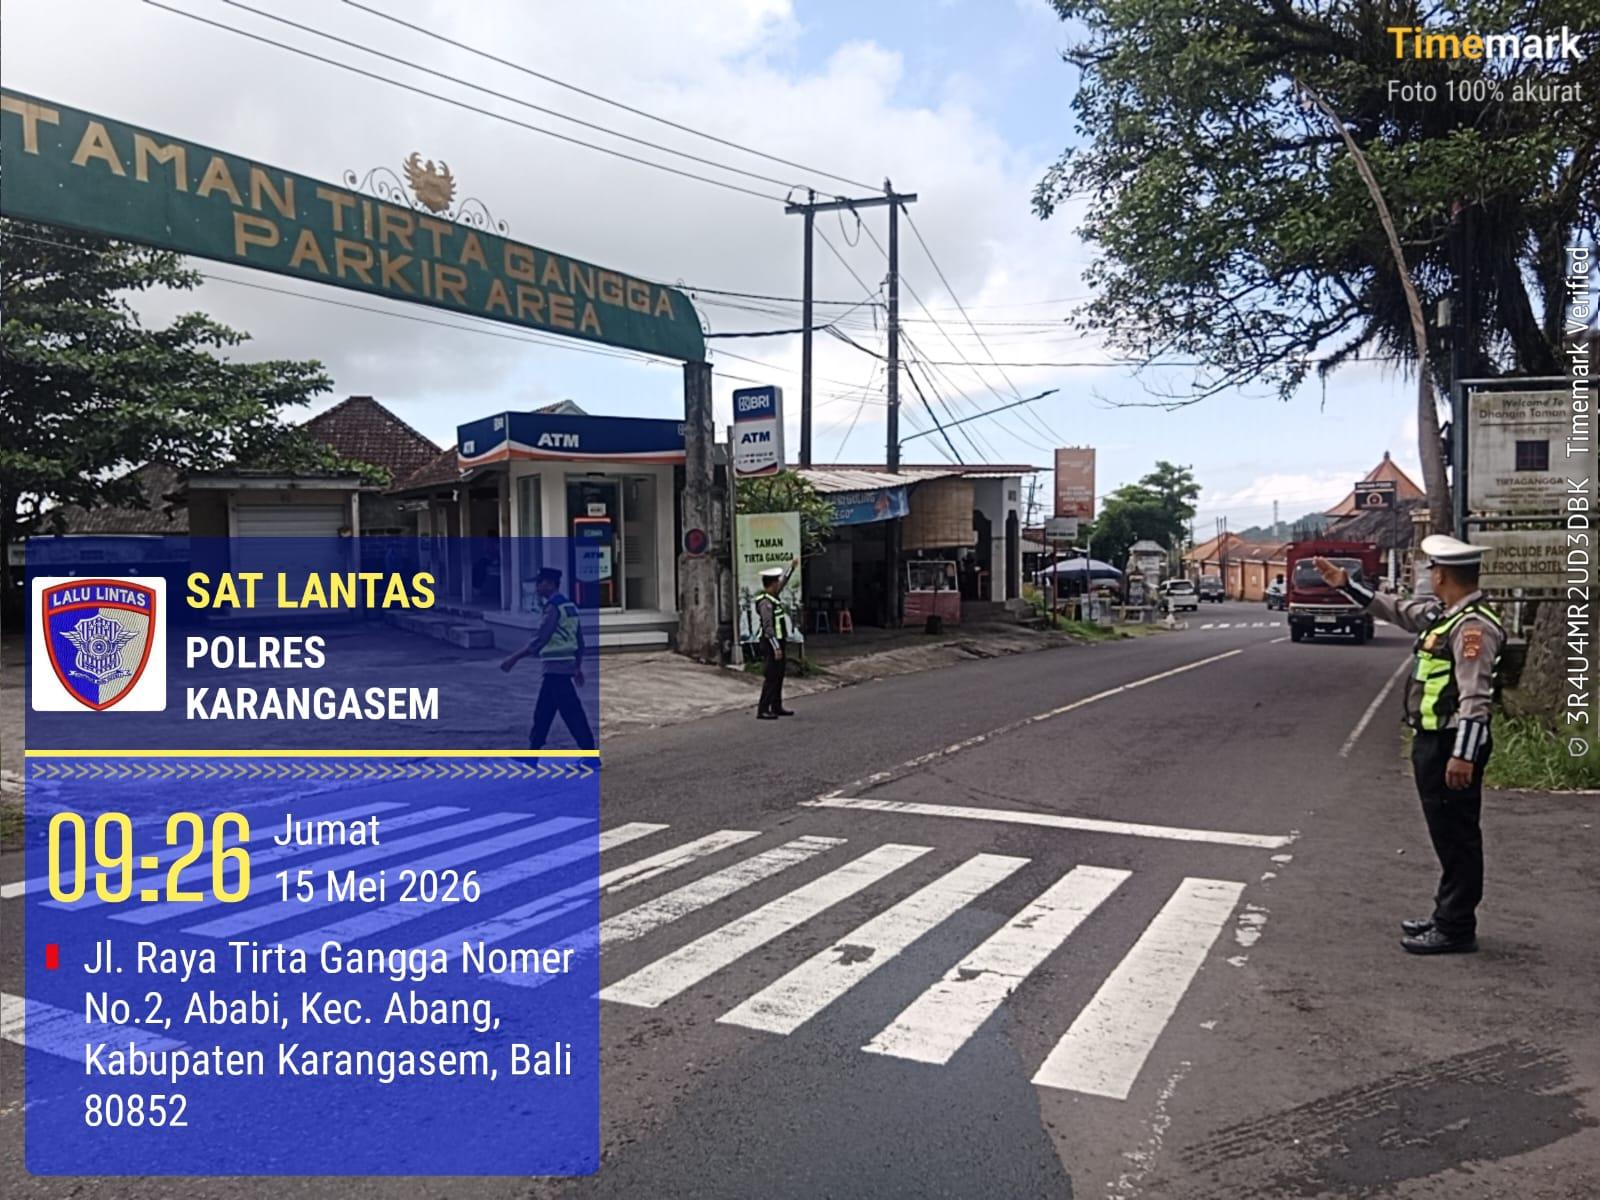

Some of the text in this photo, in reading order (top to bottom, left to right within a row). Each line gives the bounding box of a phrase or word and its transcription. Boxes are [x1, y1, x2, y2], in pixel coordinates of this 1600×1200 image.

[2, 95, 675, 321] TAMAN TIRTA GANGGA
[232, 209, 602, 336] PARKIR AREA
[1502, 397, 1550, 408] Welcome
[1530, 408, 1567, 418] Taman
[537, 432, 580, 448] ATM
[741, 431, 771, 444] ATM
[754, 538, 783, 548] TAMAN
[1497, 546, 1542, 557] INCLUDE
[744, 552, 793, 563] TIRTA GANGGA
[1531, 560, 1562, 572] HOTEL
